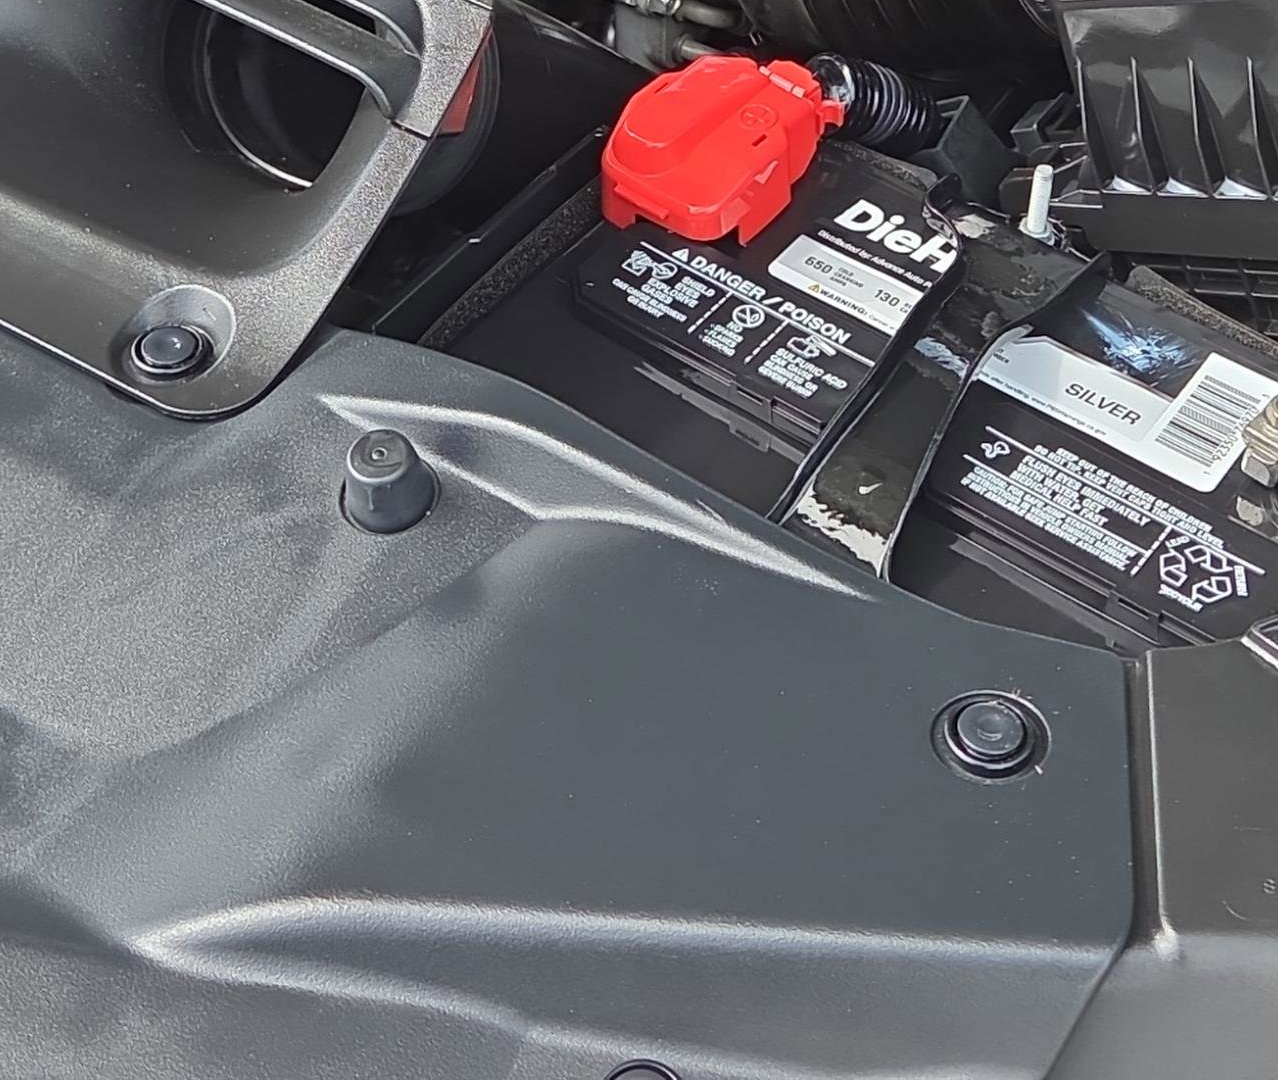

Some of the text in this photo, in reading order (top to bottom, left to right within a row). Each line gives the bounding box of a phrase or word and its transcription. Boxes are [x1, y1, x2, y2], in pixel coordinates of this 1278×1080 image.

[640, 284, 673, 304] GASES
[647, 277, 698, 307] EXPLOSIVE
[690, 255, 767, 300] DANGER
[778, 301, 851, 344] POISON
[804, 255, 832, 274] 650
[874, 289, 900, 306] 130
[726, 321, 743, 333] NO
[775, 347, 824, 376] SULFURIC
[1064, 381, 1142, 425] SILVER
[1009, 470, 1108, 526] MEDICAL HELP FAST
[1016, 463, 1044, 481] WITH
[1081, 498, 1104, 513] GET
[1022, 455, 1150, 528] FLUSH EYES IMMEDIATELY
